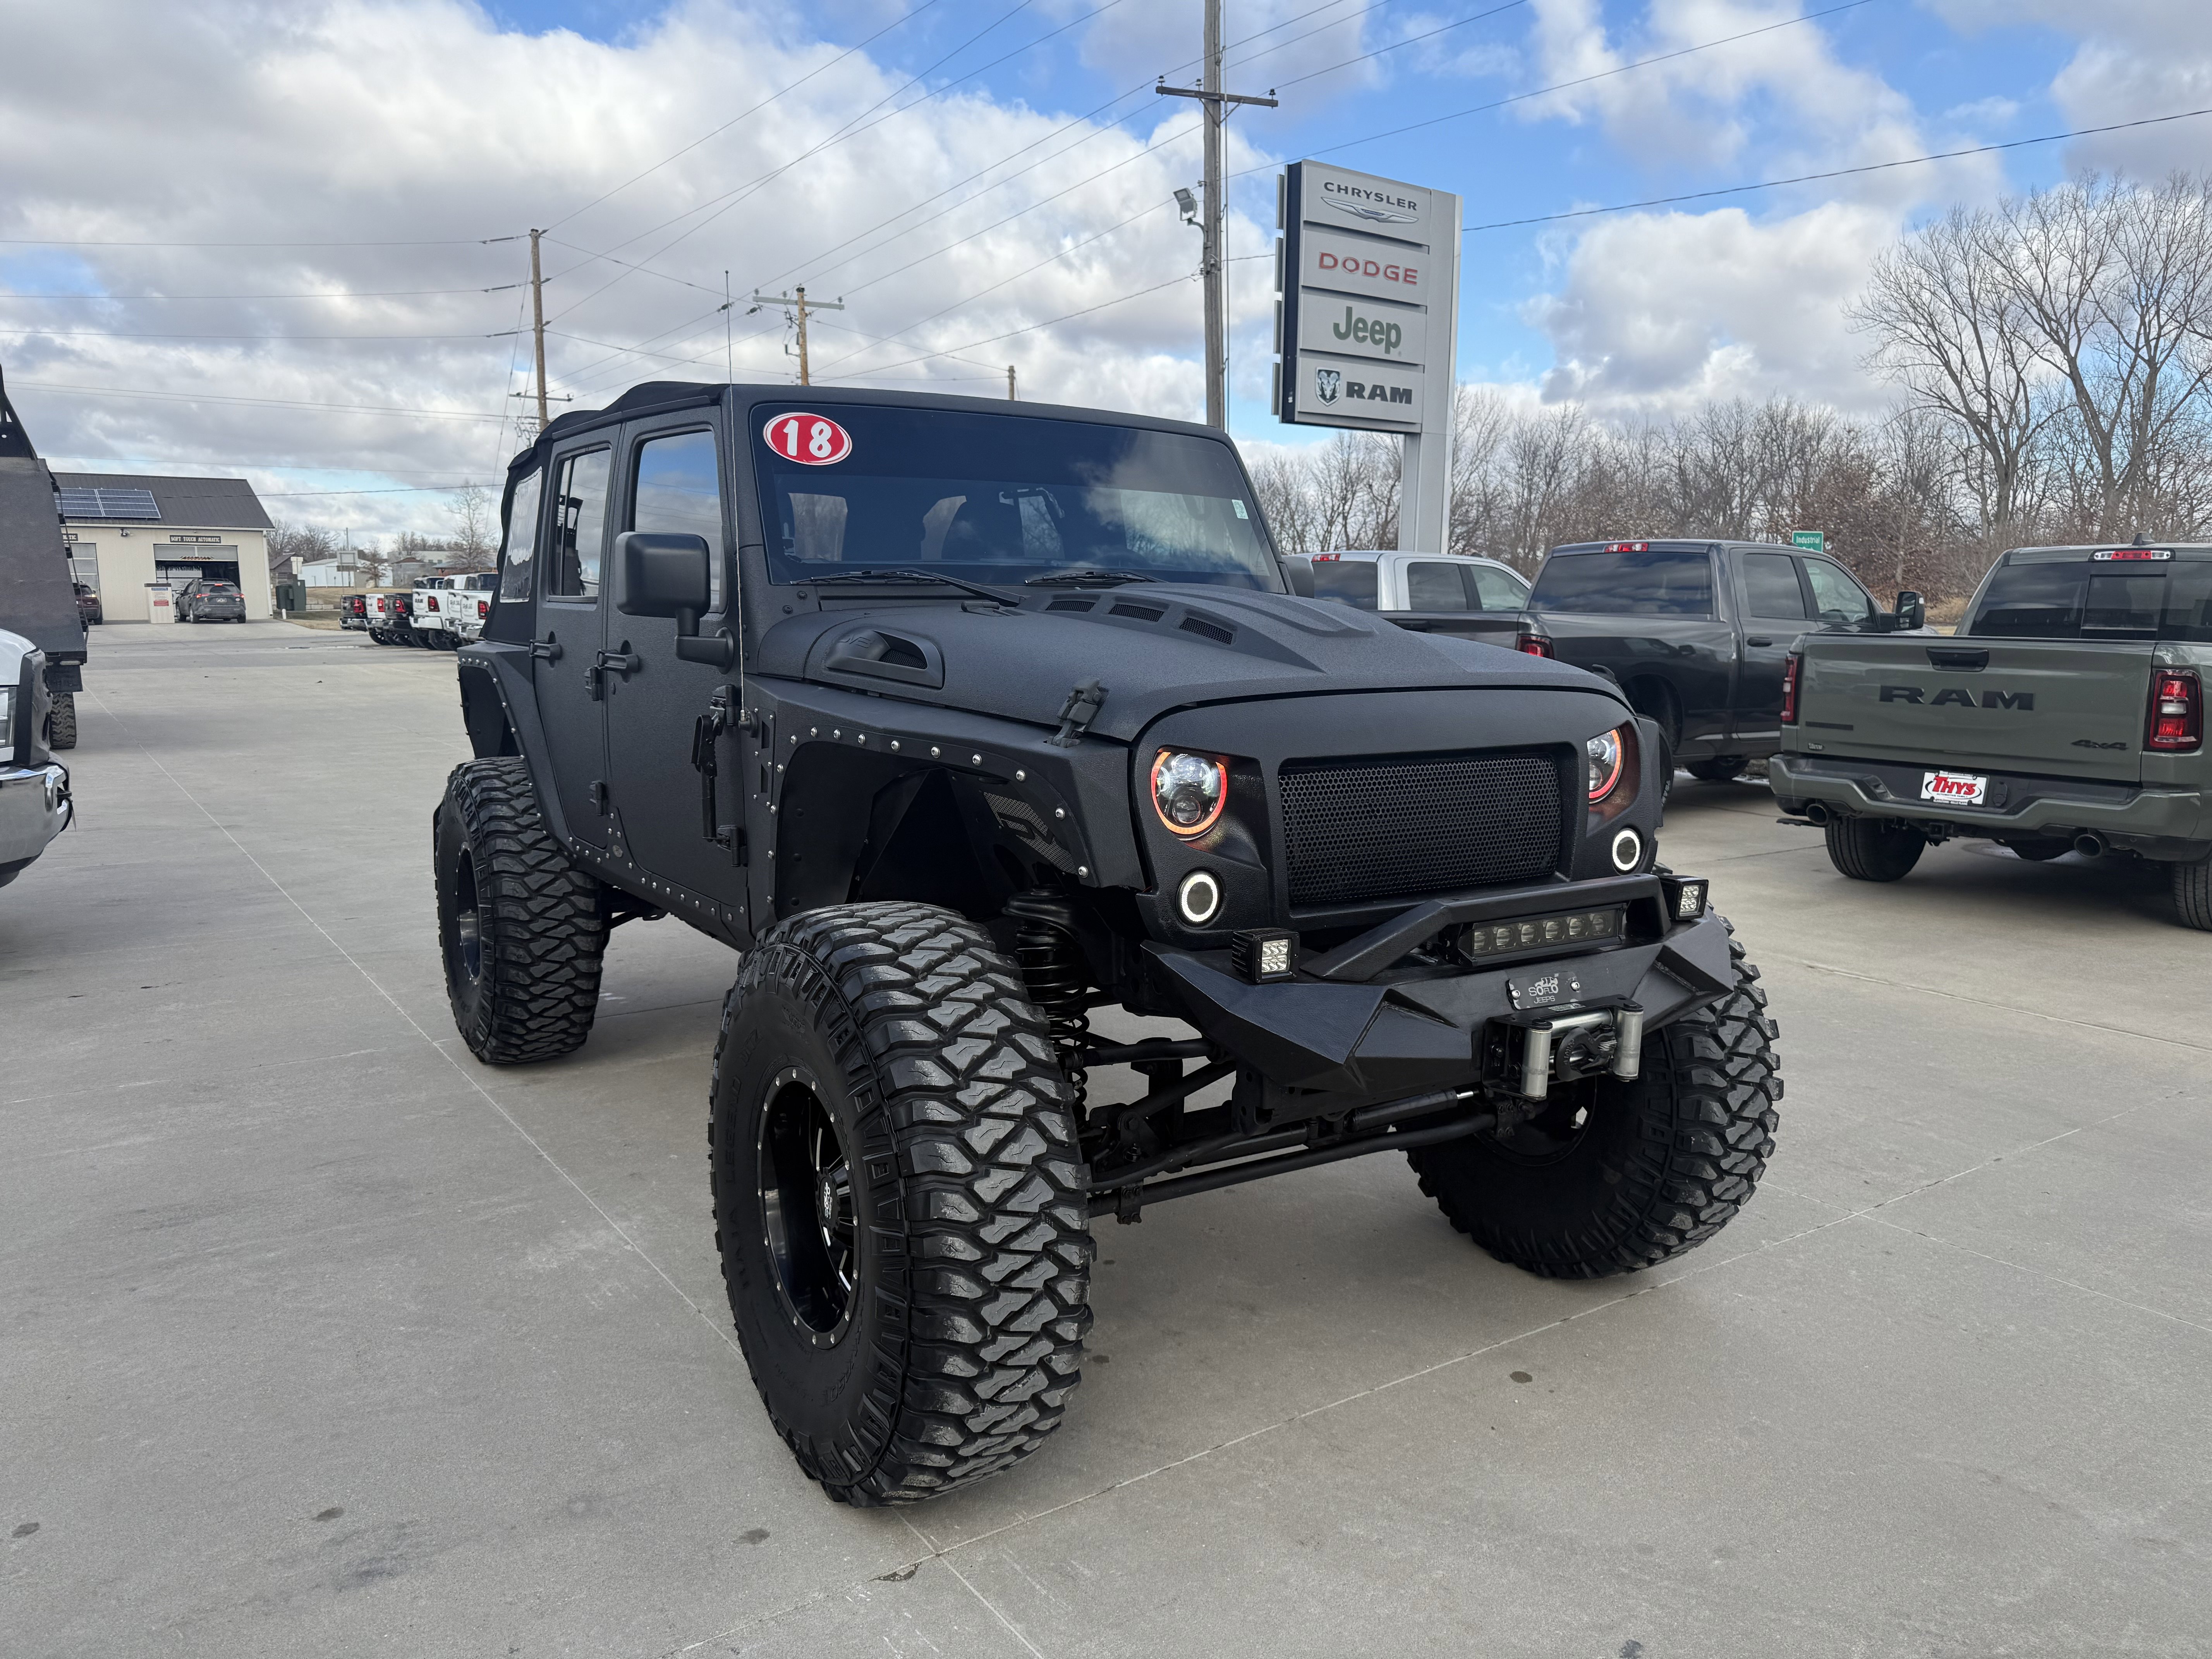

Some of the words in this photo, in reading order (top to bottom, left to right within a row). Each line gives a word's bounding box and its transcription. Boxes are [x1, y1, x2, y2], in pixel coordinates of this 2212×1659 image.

[1323, 182, 1417, 211] CHRYSLER
[1319, 252, 1418, 285] DODGE
[1333, 306, 1401, 354] Jeep
[1346, 381, 1412, 404] RAM
[783, 419, 831, 458] 18
[1796, 536, 1820, 544] Industrial
[1879, 685, 2034, 710] RAM
[1932, 776, 1977, 795] THYS
[1534, 996, 1555, 1004] JEEPS
